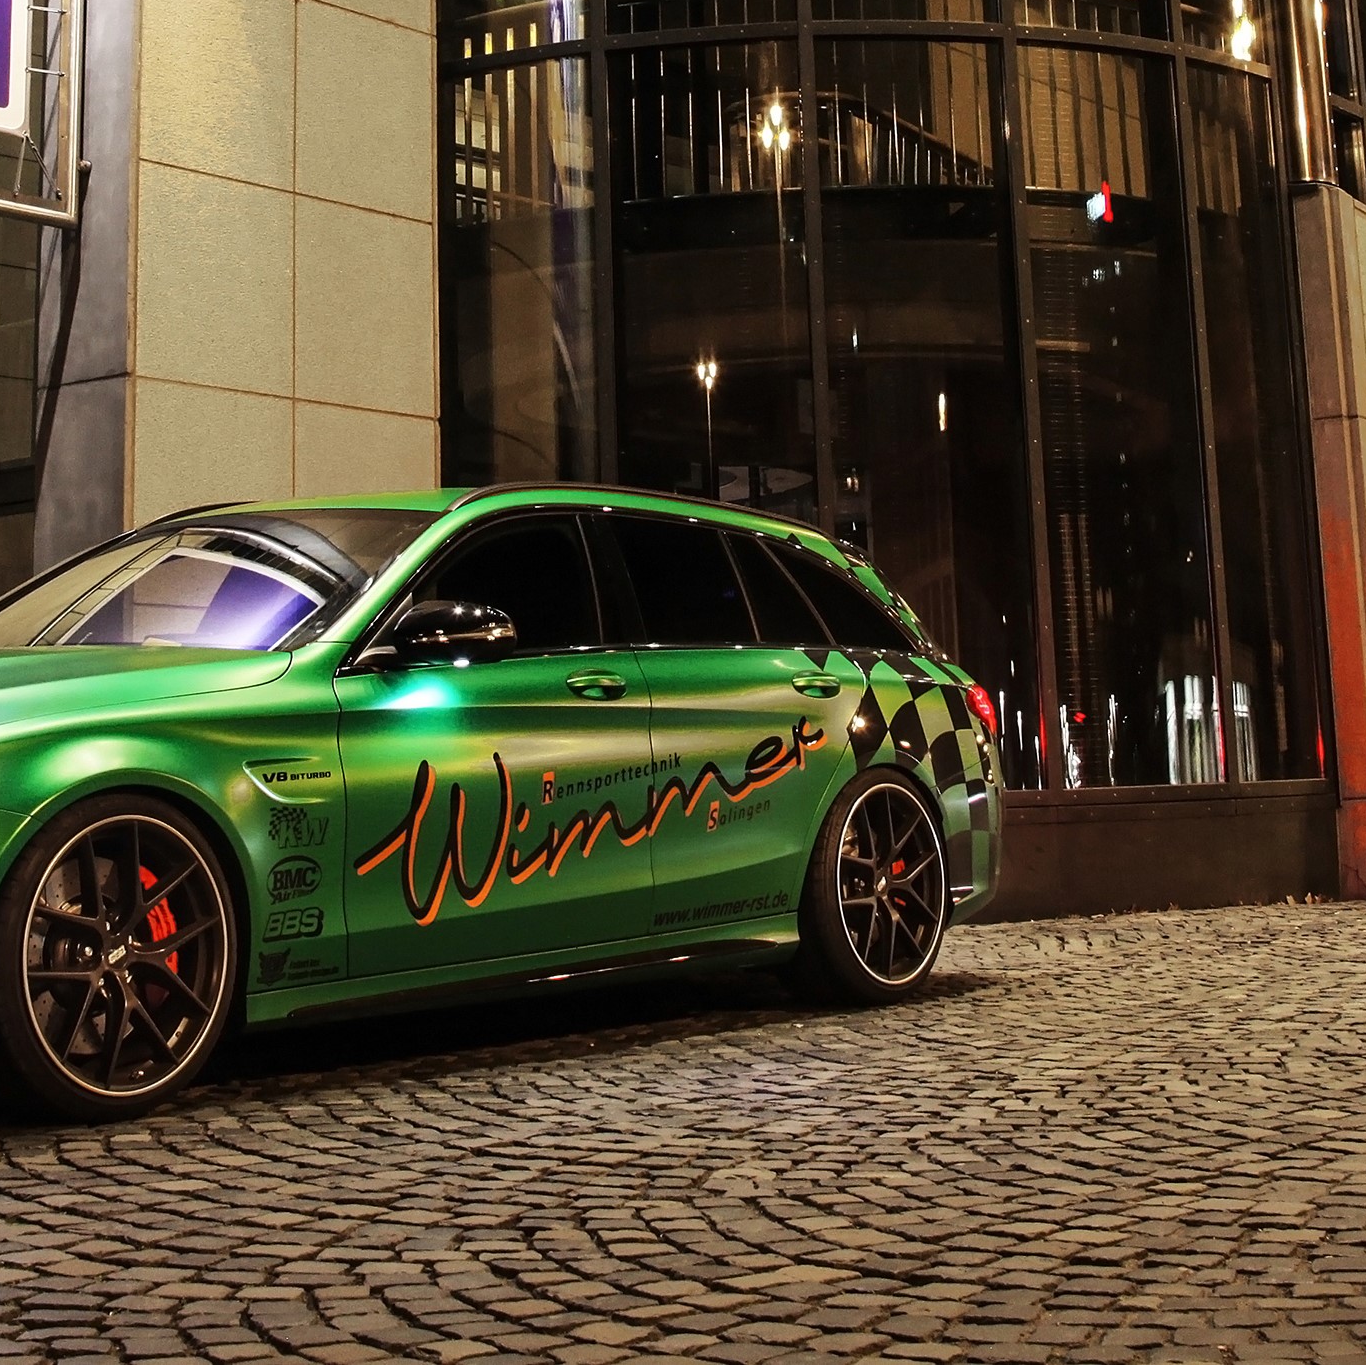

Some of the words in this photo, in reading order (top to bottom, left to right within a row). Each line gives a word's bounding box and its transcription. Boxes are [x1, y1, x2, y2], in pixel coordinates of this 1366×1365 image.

[262, 772, 288, 783] V8
[290, 771, 332, 781] BITURBO
[542, 753, 682, 804] Rennsporttechnik
[353, 715, 828, 926] Wimmer
[708, 799, 771, 831] Solingen
[277, 817, 329, 849] KW
[272, 866, 317, 892] BMC
[263, 907, 324, 943] BBS
[654, 890, 788, 926] www.wimmer-rst.de
